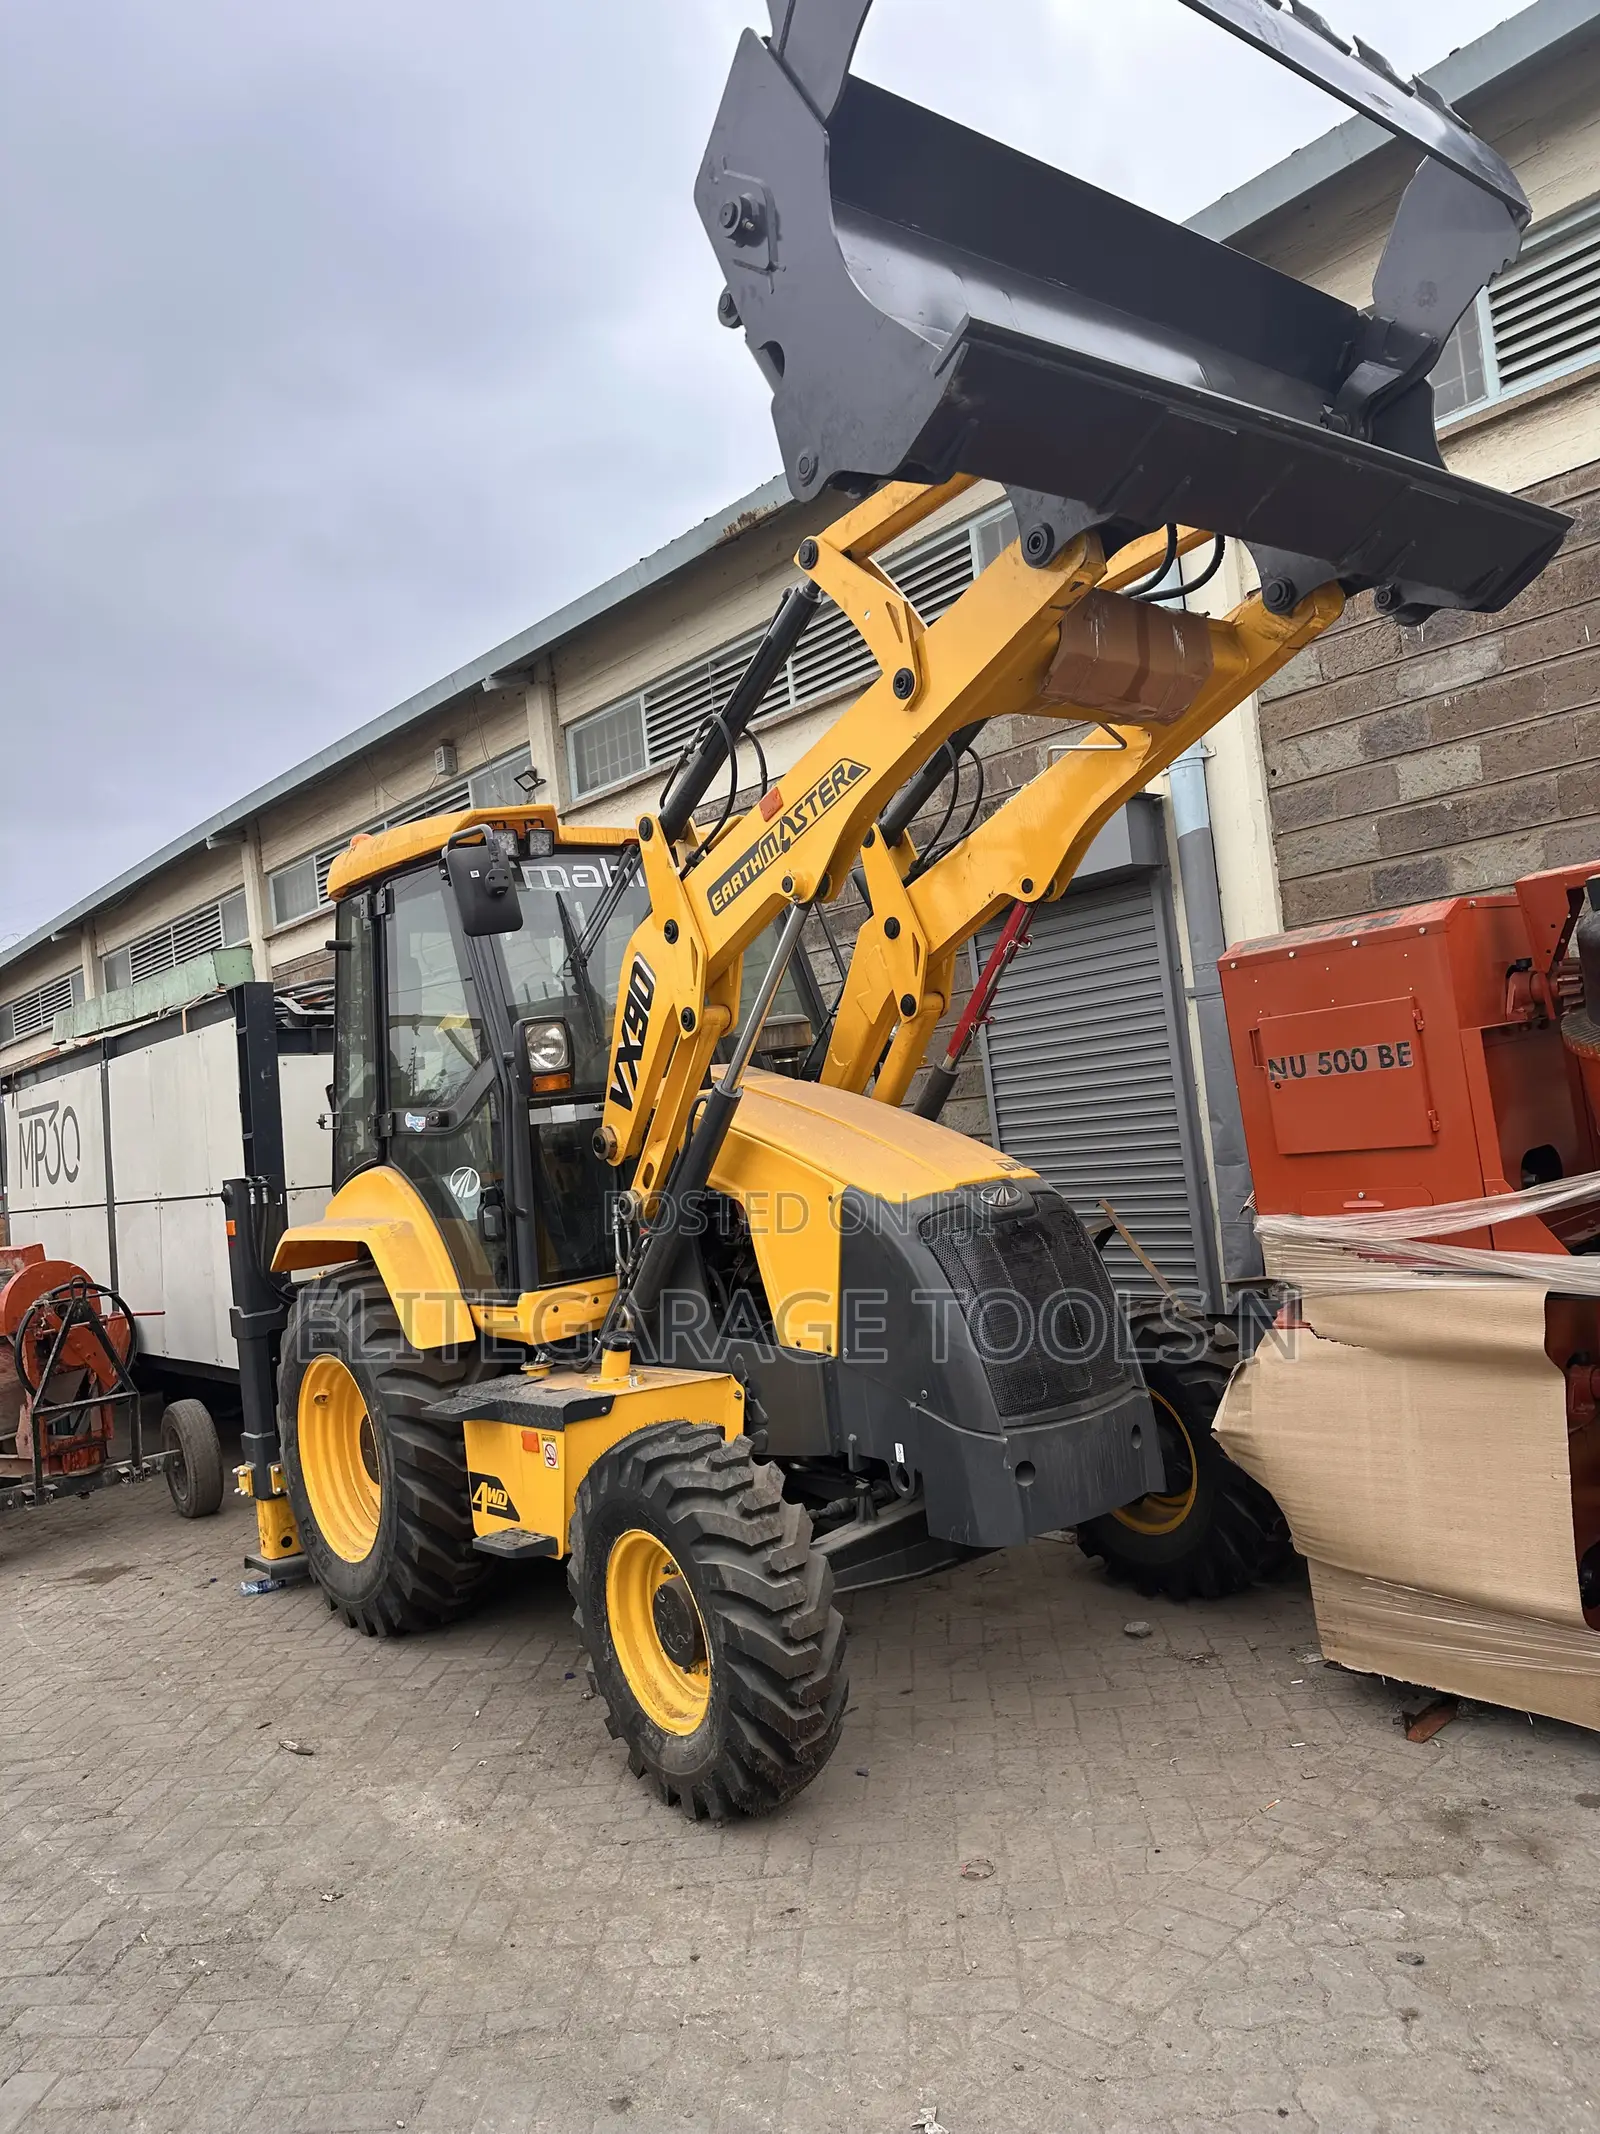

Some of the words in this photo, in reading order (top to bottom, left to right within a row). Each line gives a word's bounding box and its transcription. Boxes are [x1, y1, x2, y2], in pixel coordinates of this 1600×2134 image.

[710, 763, 851, 911] EARTHMASTER
[608, 953, 657, 1113] VX90
[1268, 1055, 1307, 1081] NU
[1317, 1047, 1368, 1076] 500
[1377, 1041, 1412, 1069] BE
[18, 1099, 81, 1190] MP30
[472, 1481, 509, 1515] 4WD
